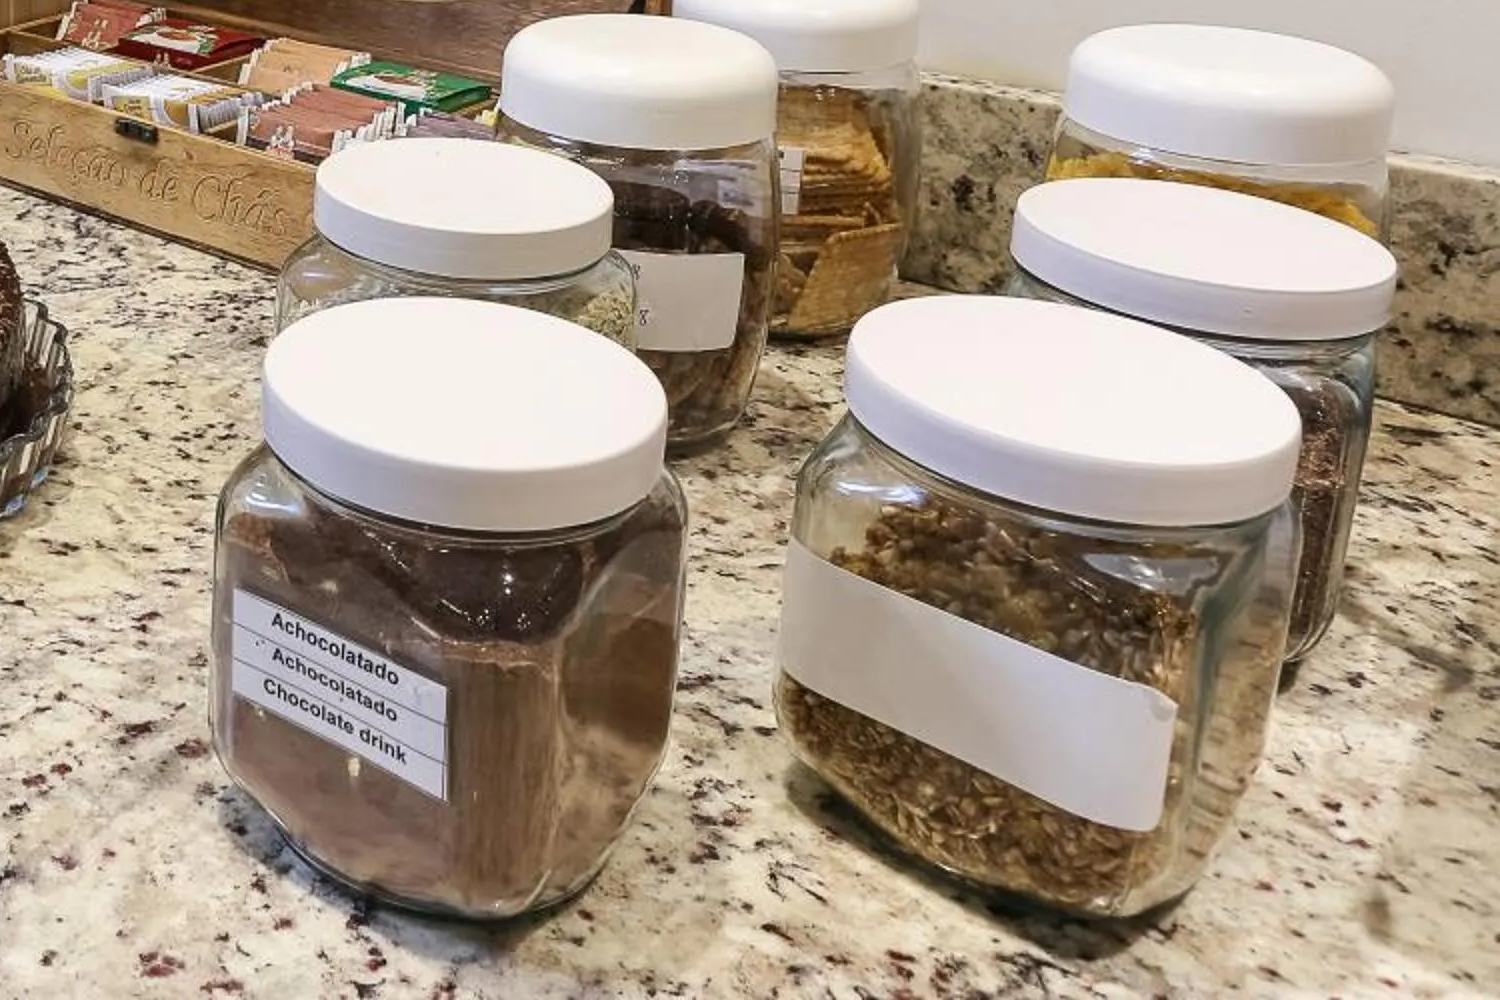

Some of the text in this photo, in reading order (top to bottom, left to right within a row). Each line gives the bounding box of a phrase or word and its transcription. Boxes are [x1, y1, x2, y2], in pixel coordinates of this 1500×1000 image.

[138, 157, 180, 202] de
[271, 612, 399, 686] Achocolatado
[271, 647, 398, 722] Achocolatado
[262, 678, 407, 766] Chocolate drink
